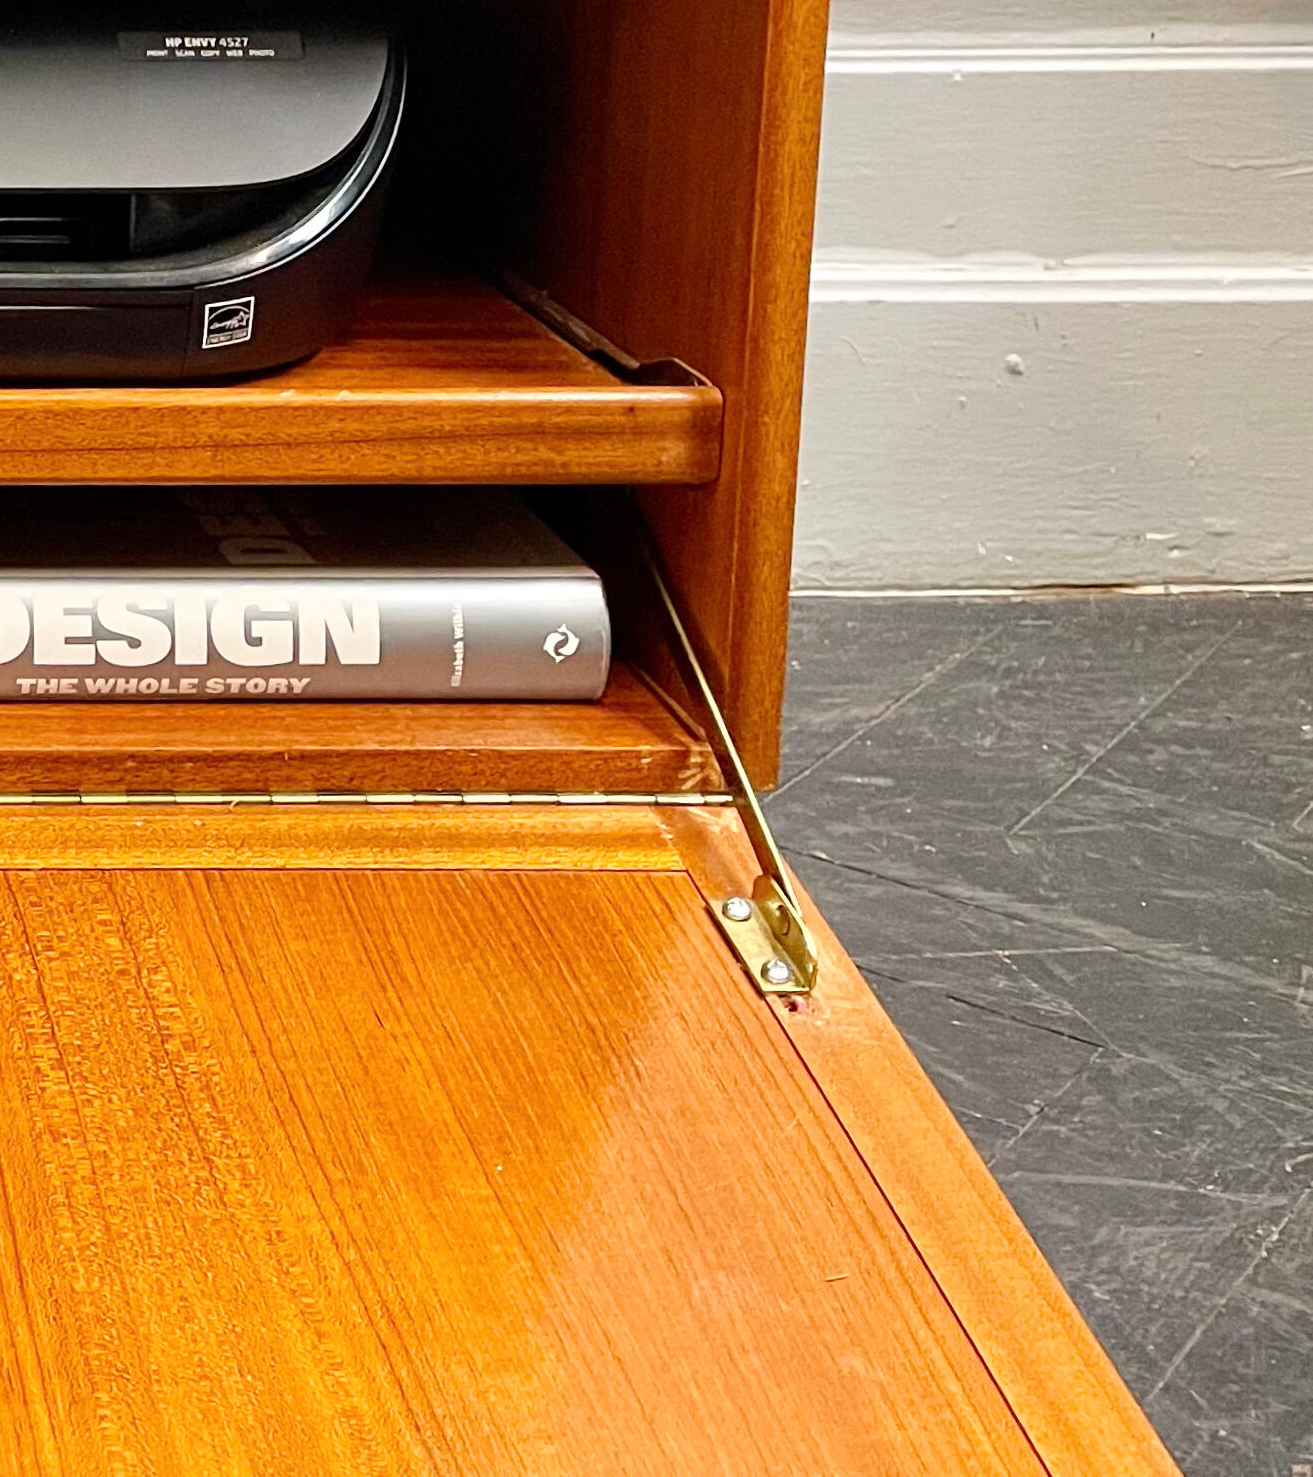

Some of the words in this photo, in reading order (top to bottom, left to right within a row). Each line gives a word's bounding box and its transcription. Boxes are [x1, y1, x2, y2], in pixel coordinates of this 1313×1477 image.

[165, 37, 183, 48] HP
[184, 37, 217, 48] ENVY
[218, 37, 249, 48] 4527
[15, 677, 79, 695] THE
[84, 677, 199, 695] WHOLE
[205, 677, 312, 695] STORY
